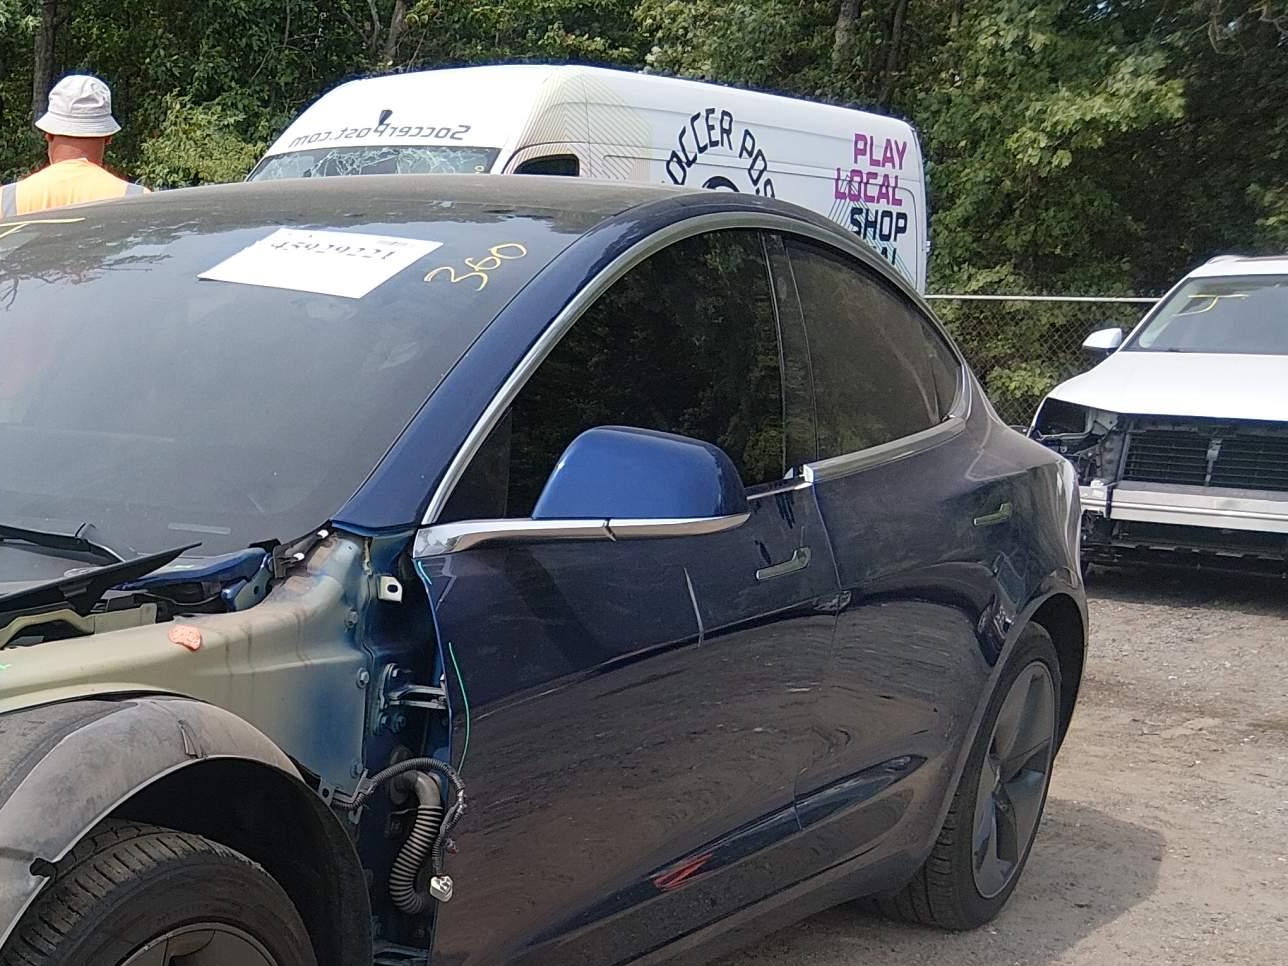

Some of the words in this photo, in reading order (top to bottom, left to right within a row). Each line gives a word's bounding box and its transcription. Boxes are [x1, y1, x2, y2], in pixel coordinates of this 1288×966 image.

[665, 107, 734, 186] OCCER
[853, 132, 907, 170] PLAY
[834, 167, 903, 207] LOCAL
[850, 206, 908, 242] SHOP
[423, 242, 529, 292] 360
